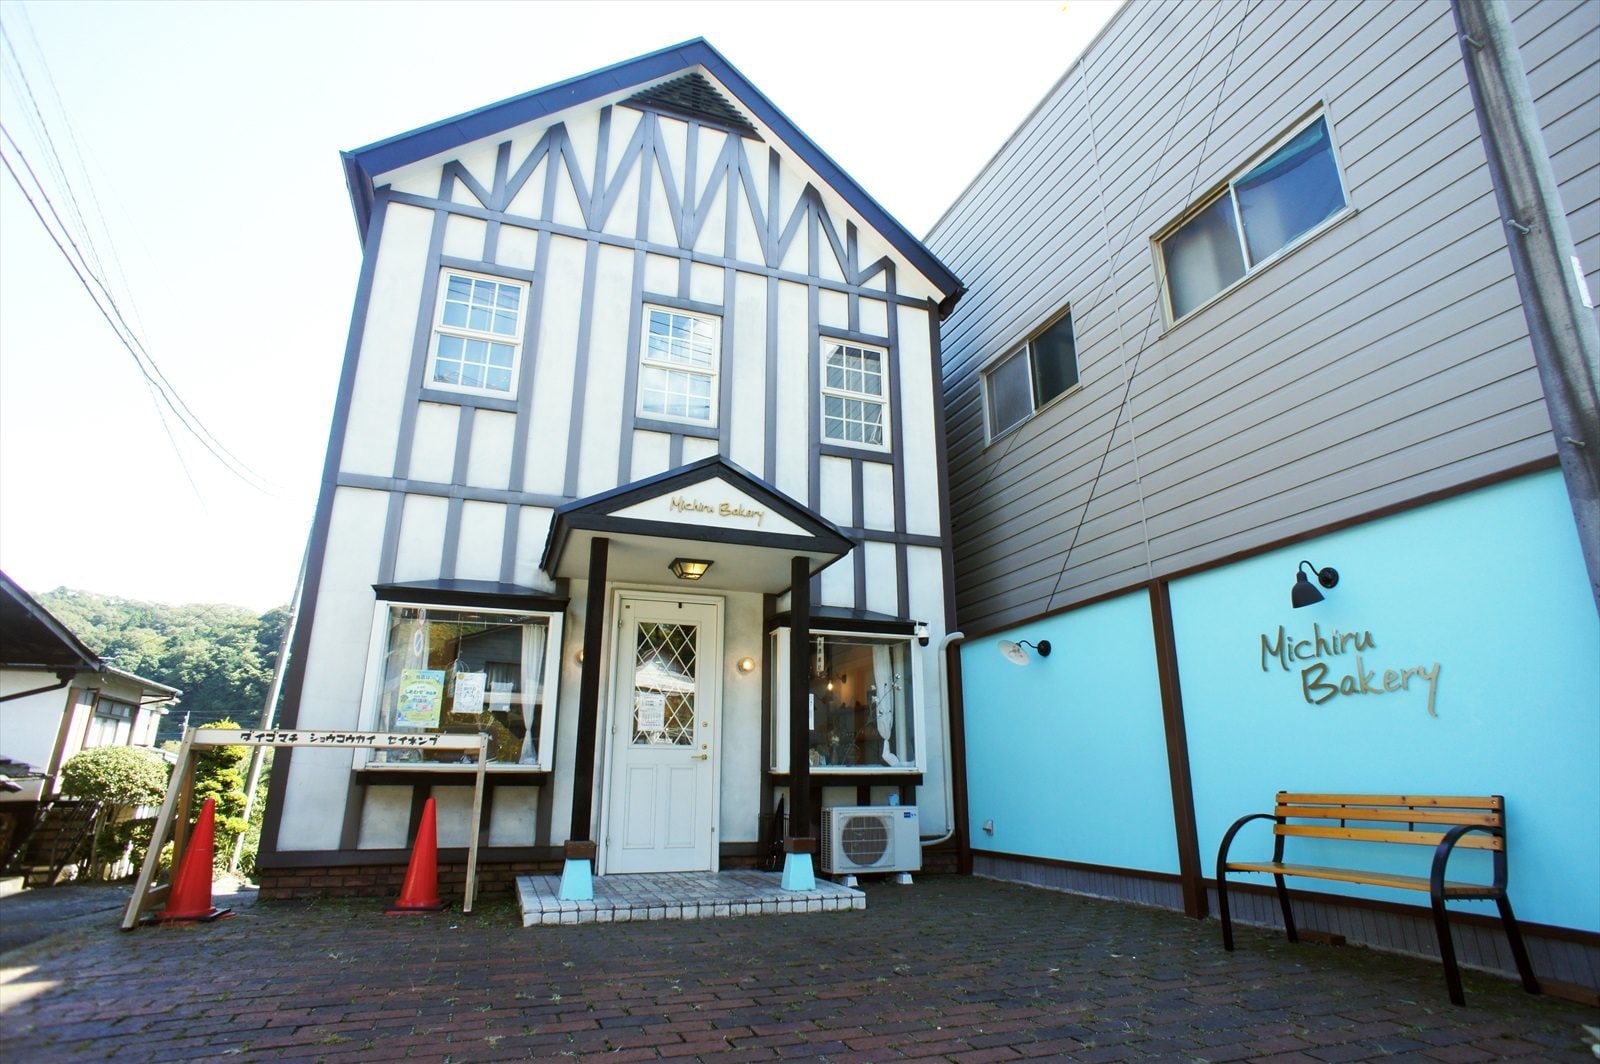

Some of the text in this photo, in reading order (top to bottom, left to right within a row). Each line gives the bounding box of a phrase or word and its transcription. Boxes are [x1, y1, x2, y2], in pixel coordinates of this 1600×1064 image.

[670, 497, 764, 527] Michiru Bakery
[1260, 622, 1376, 672] Michiru
[1301, 655, 1441, 718] Bakery
[240, 729, 441, 746] ダイゴマチ ショウコウカイ セイネンブ
